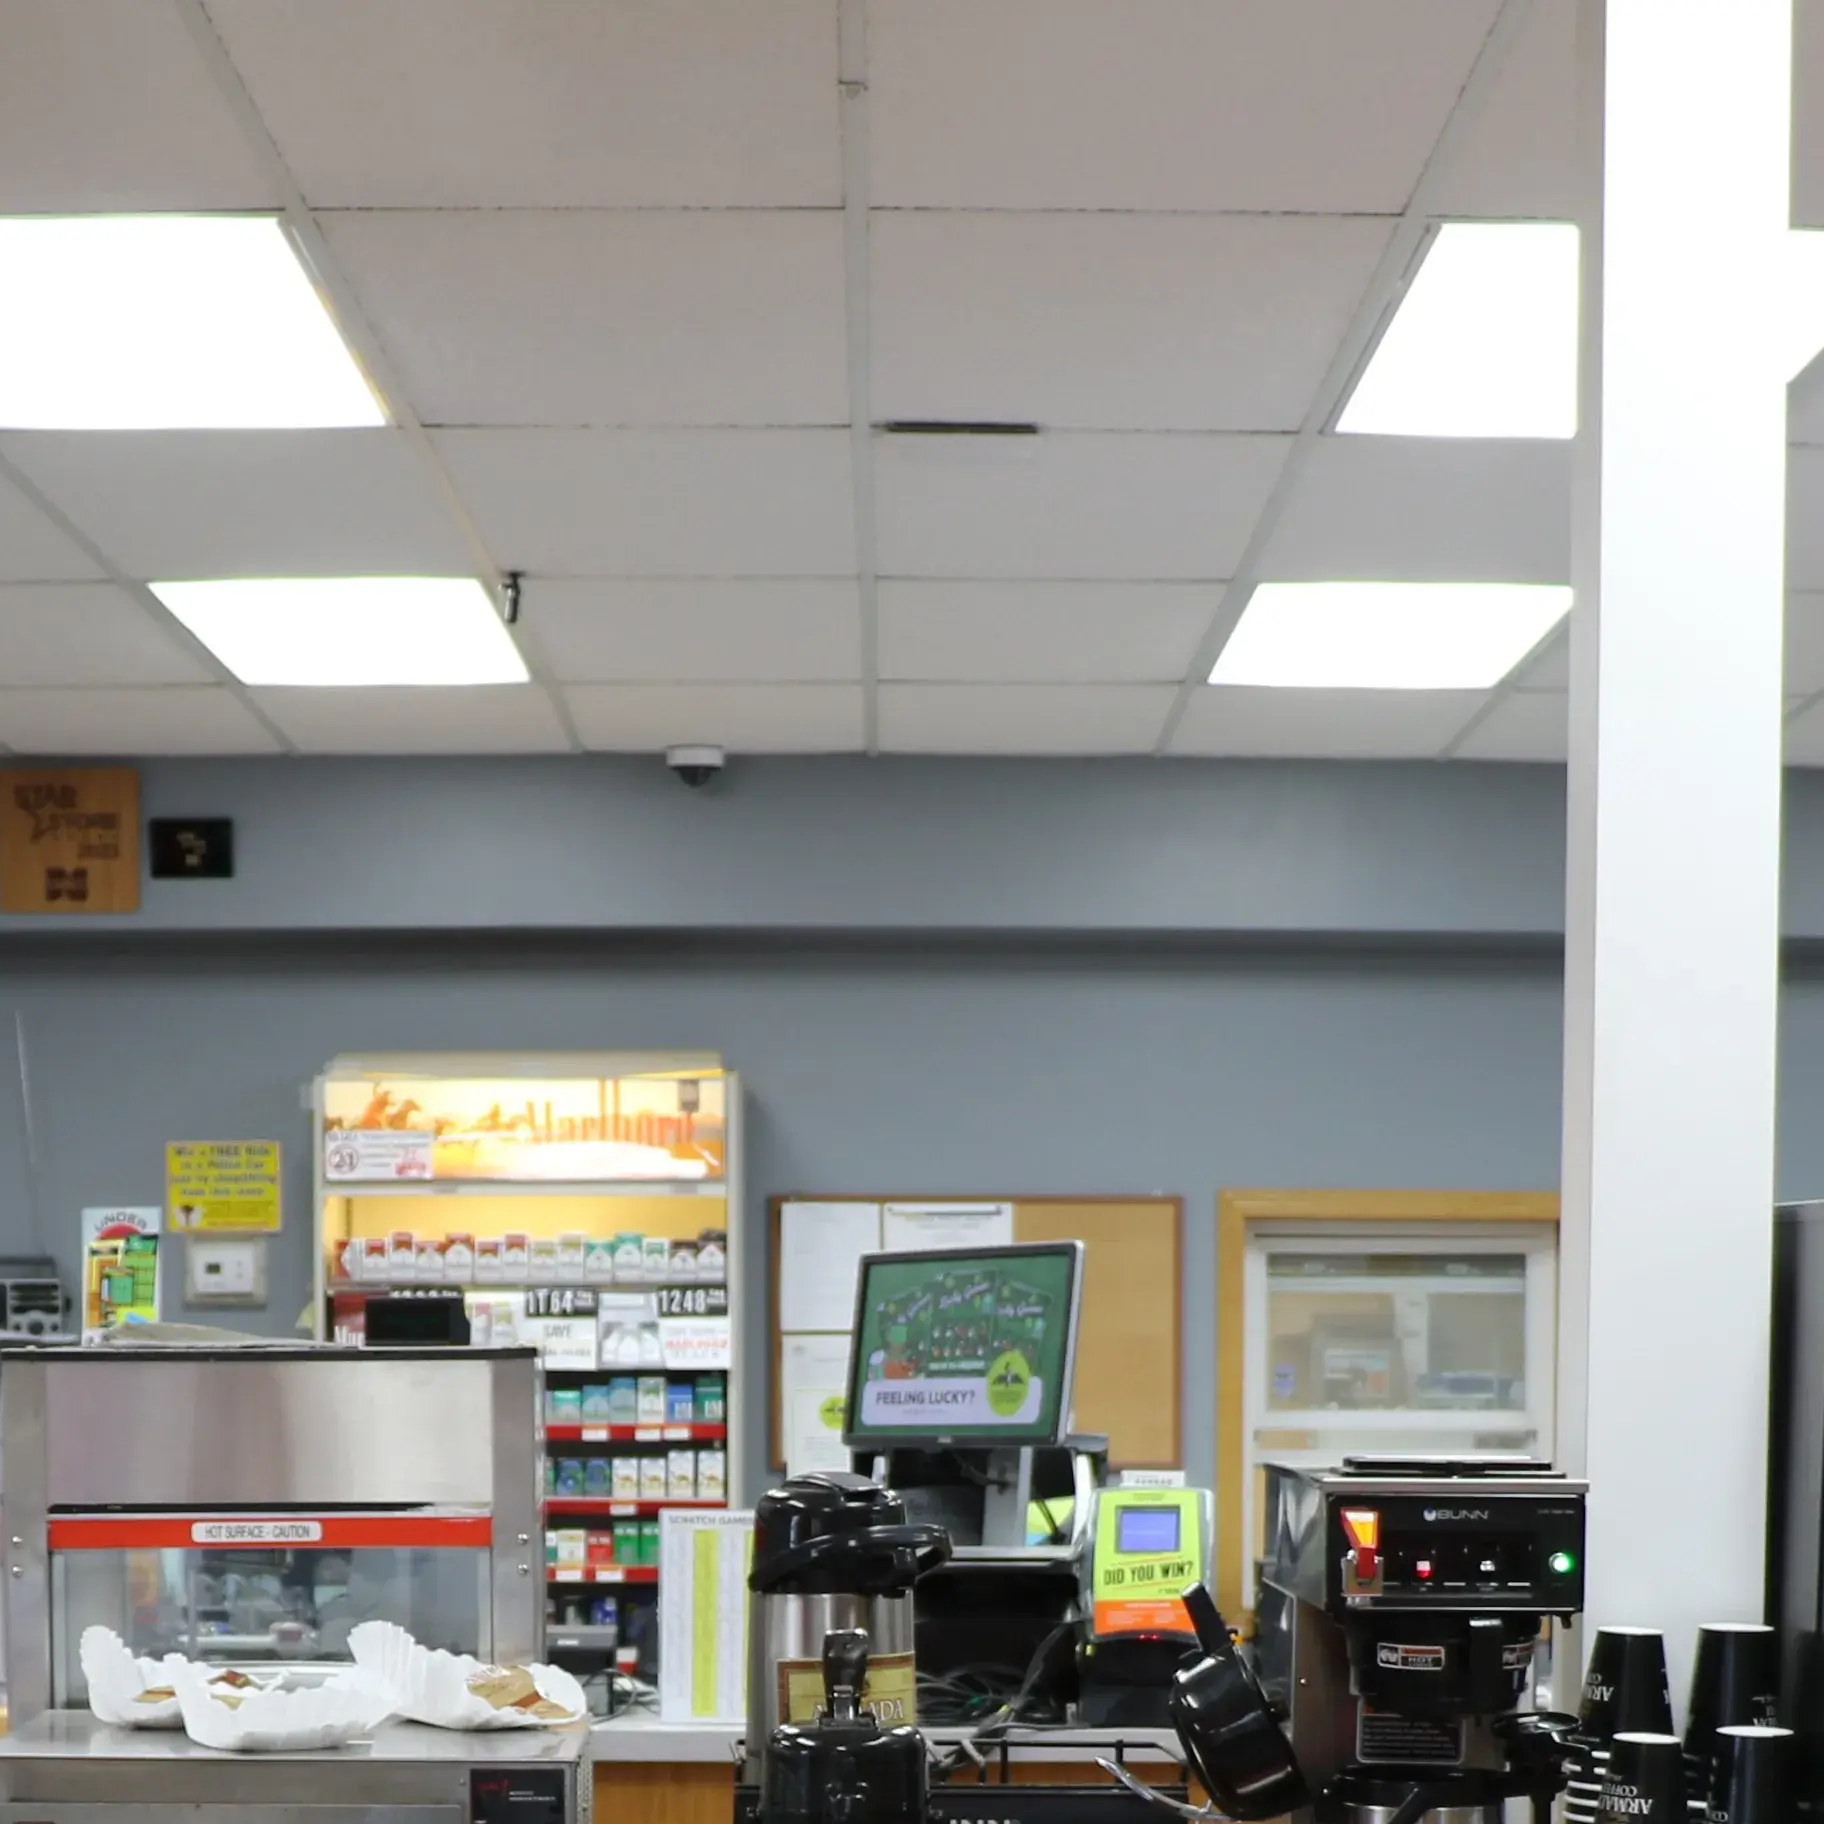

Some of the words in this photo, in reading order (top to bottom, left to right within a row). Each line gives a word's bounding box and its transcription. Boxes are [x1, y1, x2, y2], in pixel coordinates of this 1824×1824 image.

[876, 1390, 925, 1405] FEELING
[928, 1389, 976, 1405] LUCKY?
[1437, 1510, 1488, 1520] BUNN
[205, 1525, 222, 1538] HOT
[226, 1525, 264, 1539] SURFACE
[273, 1524, 310, 1538] CAUTION
[1103, 1568, 1125, 1586] DID
[1130, 1564, 1155, 1583] YOU
[1161, 1560, 1194, 1578] WIN?
[814, 1698, 904, 1721] AADA
